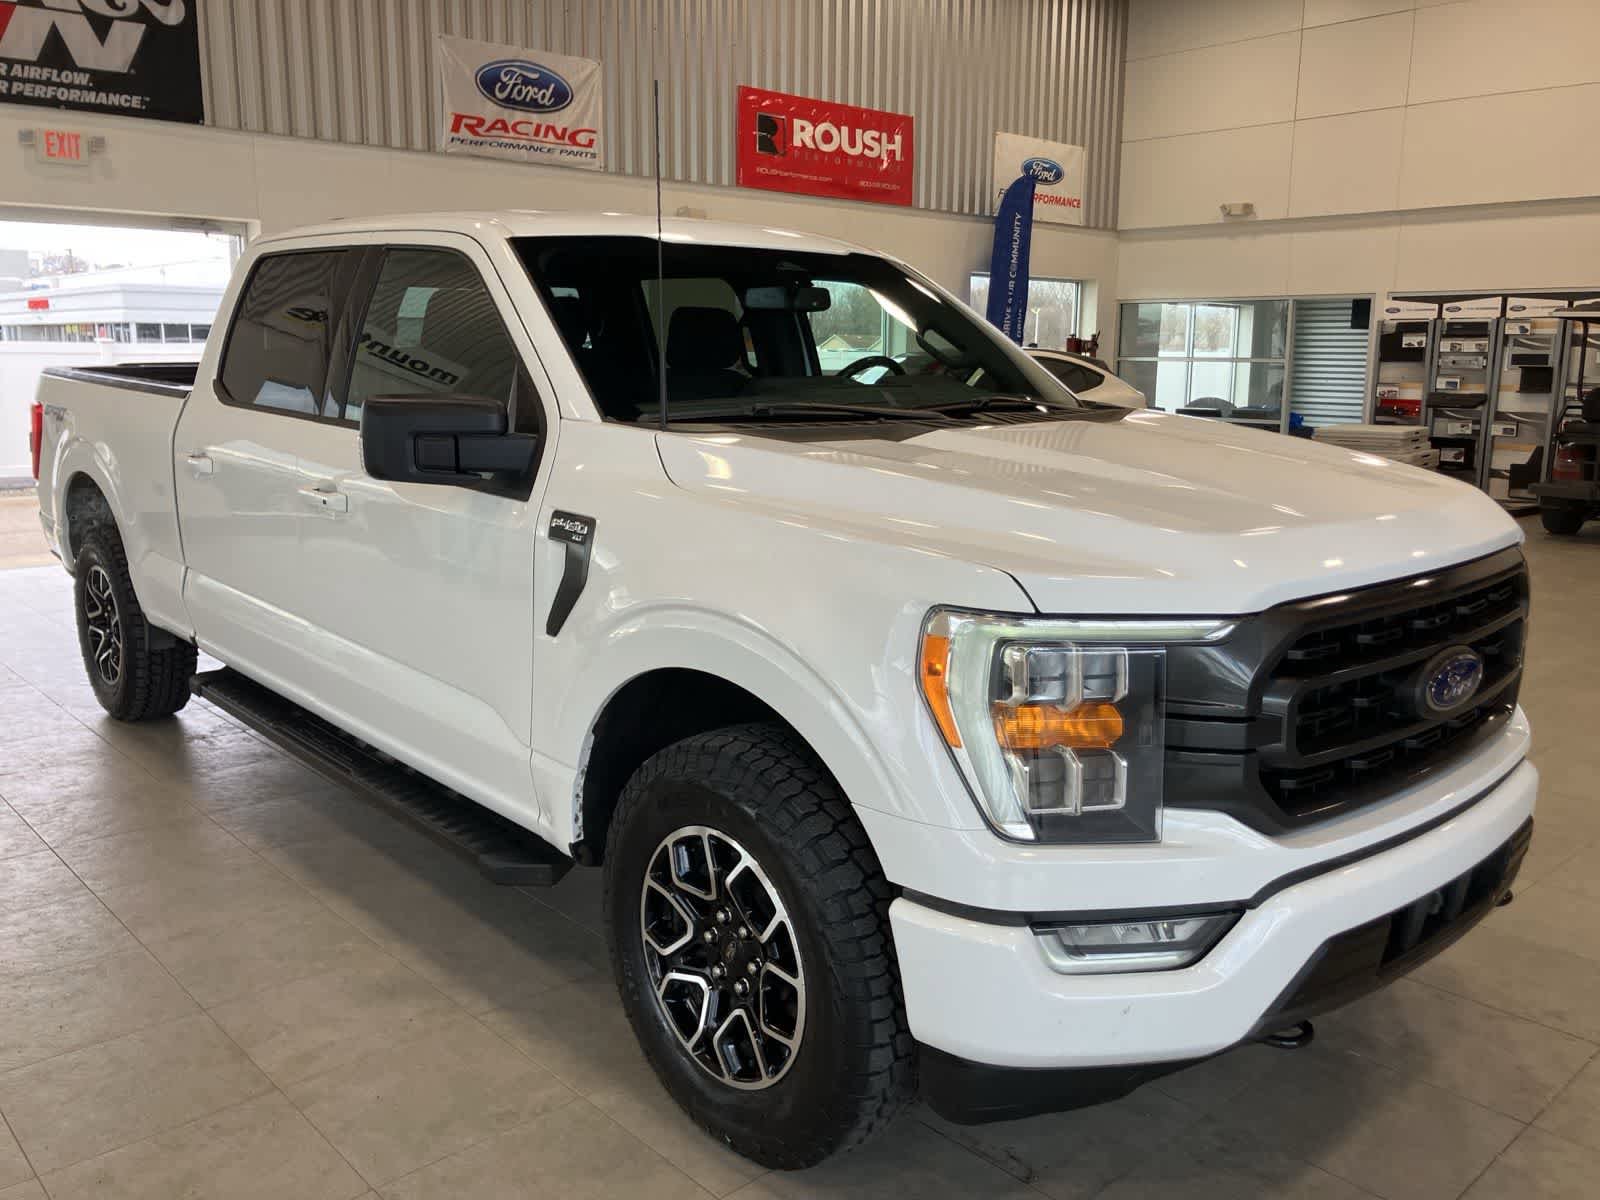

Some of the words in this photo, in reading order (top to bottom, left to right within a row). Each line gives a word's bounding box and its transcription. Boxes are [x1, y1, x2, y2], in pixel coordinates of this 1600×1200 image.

[11, 64, 93, 87] AIRFLOW.
[494, 67, 556, 106] Ford
[11, 81, 147, 110] PERFORMANCE.
[44, 129, 81, 160] EXIT
[451, 113, 598, 148] RACING
[792, 118, 904, 162] ROUSH
[450, 136, 555, 155] PERFORMANCE
[559, 149, 598, 160] PARTS
[1029, 160, 1057, 182] Ford
[1032, 192, 1081, 209] RFORMANCE
[1009, 211, 1023, 279] COMMUNITY
